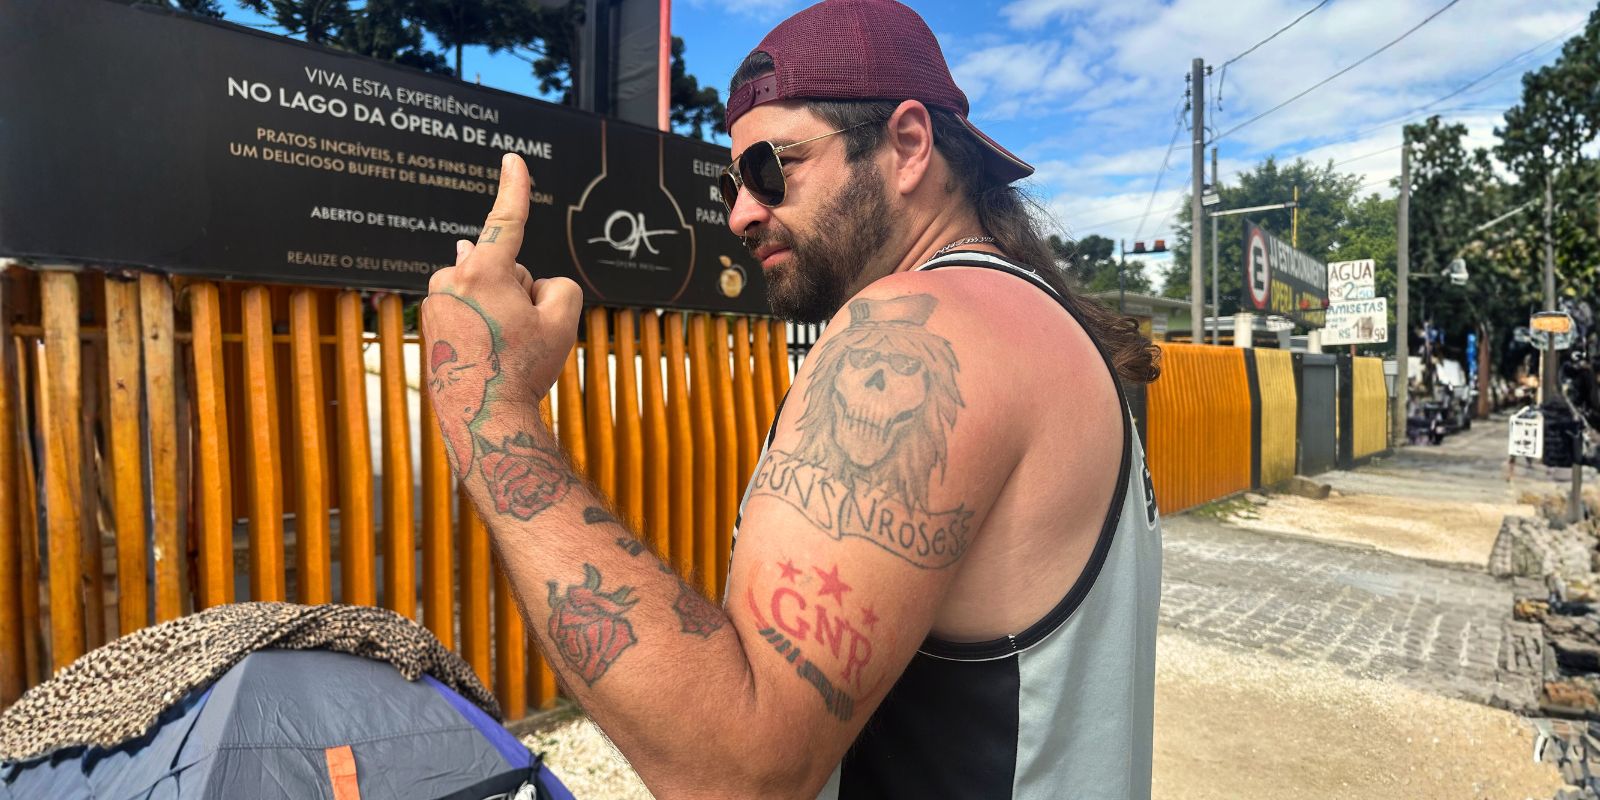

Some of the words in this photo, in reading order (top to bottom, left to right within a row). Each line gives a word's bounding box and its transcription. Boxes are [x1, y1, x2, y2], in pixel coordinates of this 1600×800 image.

[227, 76, 272, 103] NO
[279, 87, 348, 118] LAGO
[353, 103, 386, 126] DA
[390, 106, 458, 141] ÓPERA
[462, 125, 487, 146] DE
[490, 133, 552, 160] ARAME
[304, 66, 348, 91] VIVA
[352, 77, 393, 101] ESTA
[396, 87, 499, 124] EXPERIÊNCIA!
[229, 142, 258, 159] UM
[262, 147, 345, 172] DELICIOSO
[347, 161, 397, 180] BUFFET
[399, 169, 416, 183] DE
[418, 172, 486, 194] BARREADO
[488, 183, 495, 195] E
[256, 127, 317, 149] PRATOS
[320, 137, 393, 164] INCRÍVEIS,
[397, 152, 405, 164] E
[407, 154, 436, 170] AOS
[438, 158, 466, 175] FINS
[468, 164, 483, 178] DE
[310, 206, 365, 225] ABERTO
[367, 213, 385, 227] DE
[386, 214, 426, 233] TERÇA
[427, 216, 439, 233] À
[695, 206, 726, 226] PARA
[287, 250, 337, 267] REALIZE
[340, 255, 354, 268] O
[356, 256, 380, 270] SEU
[383, 258, 430, 275] EVENTO
[1252, 246, 1265, 291] E
[755, 455, 836, 530] GUNS
[770, 586, 872, 690] GNR
